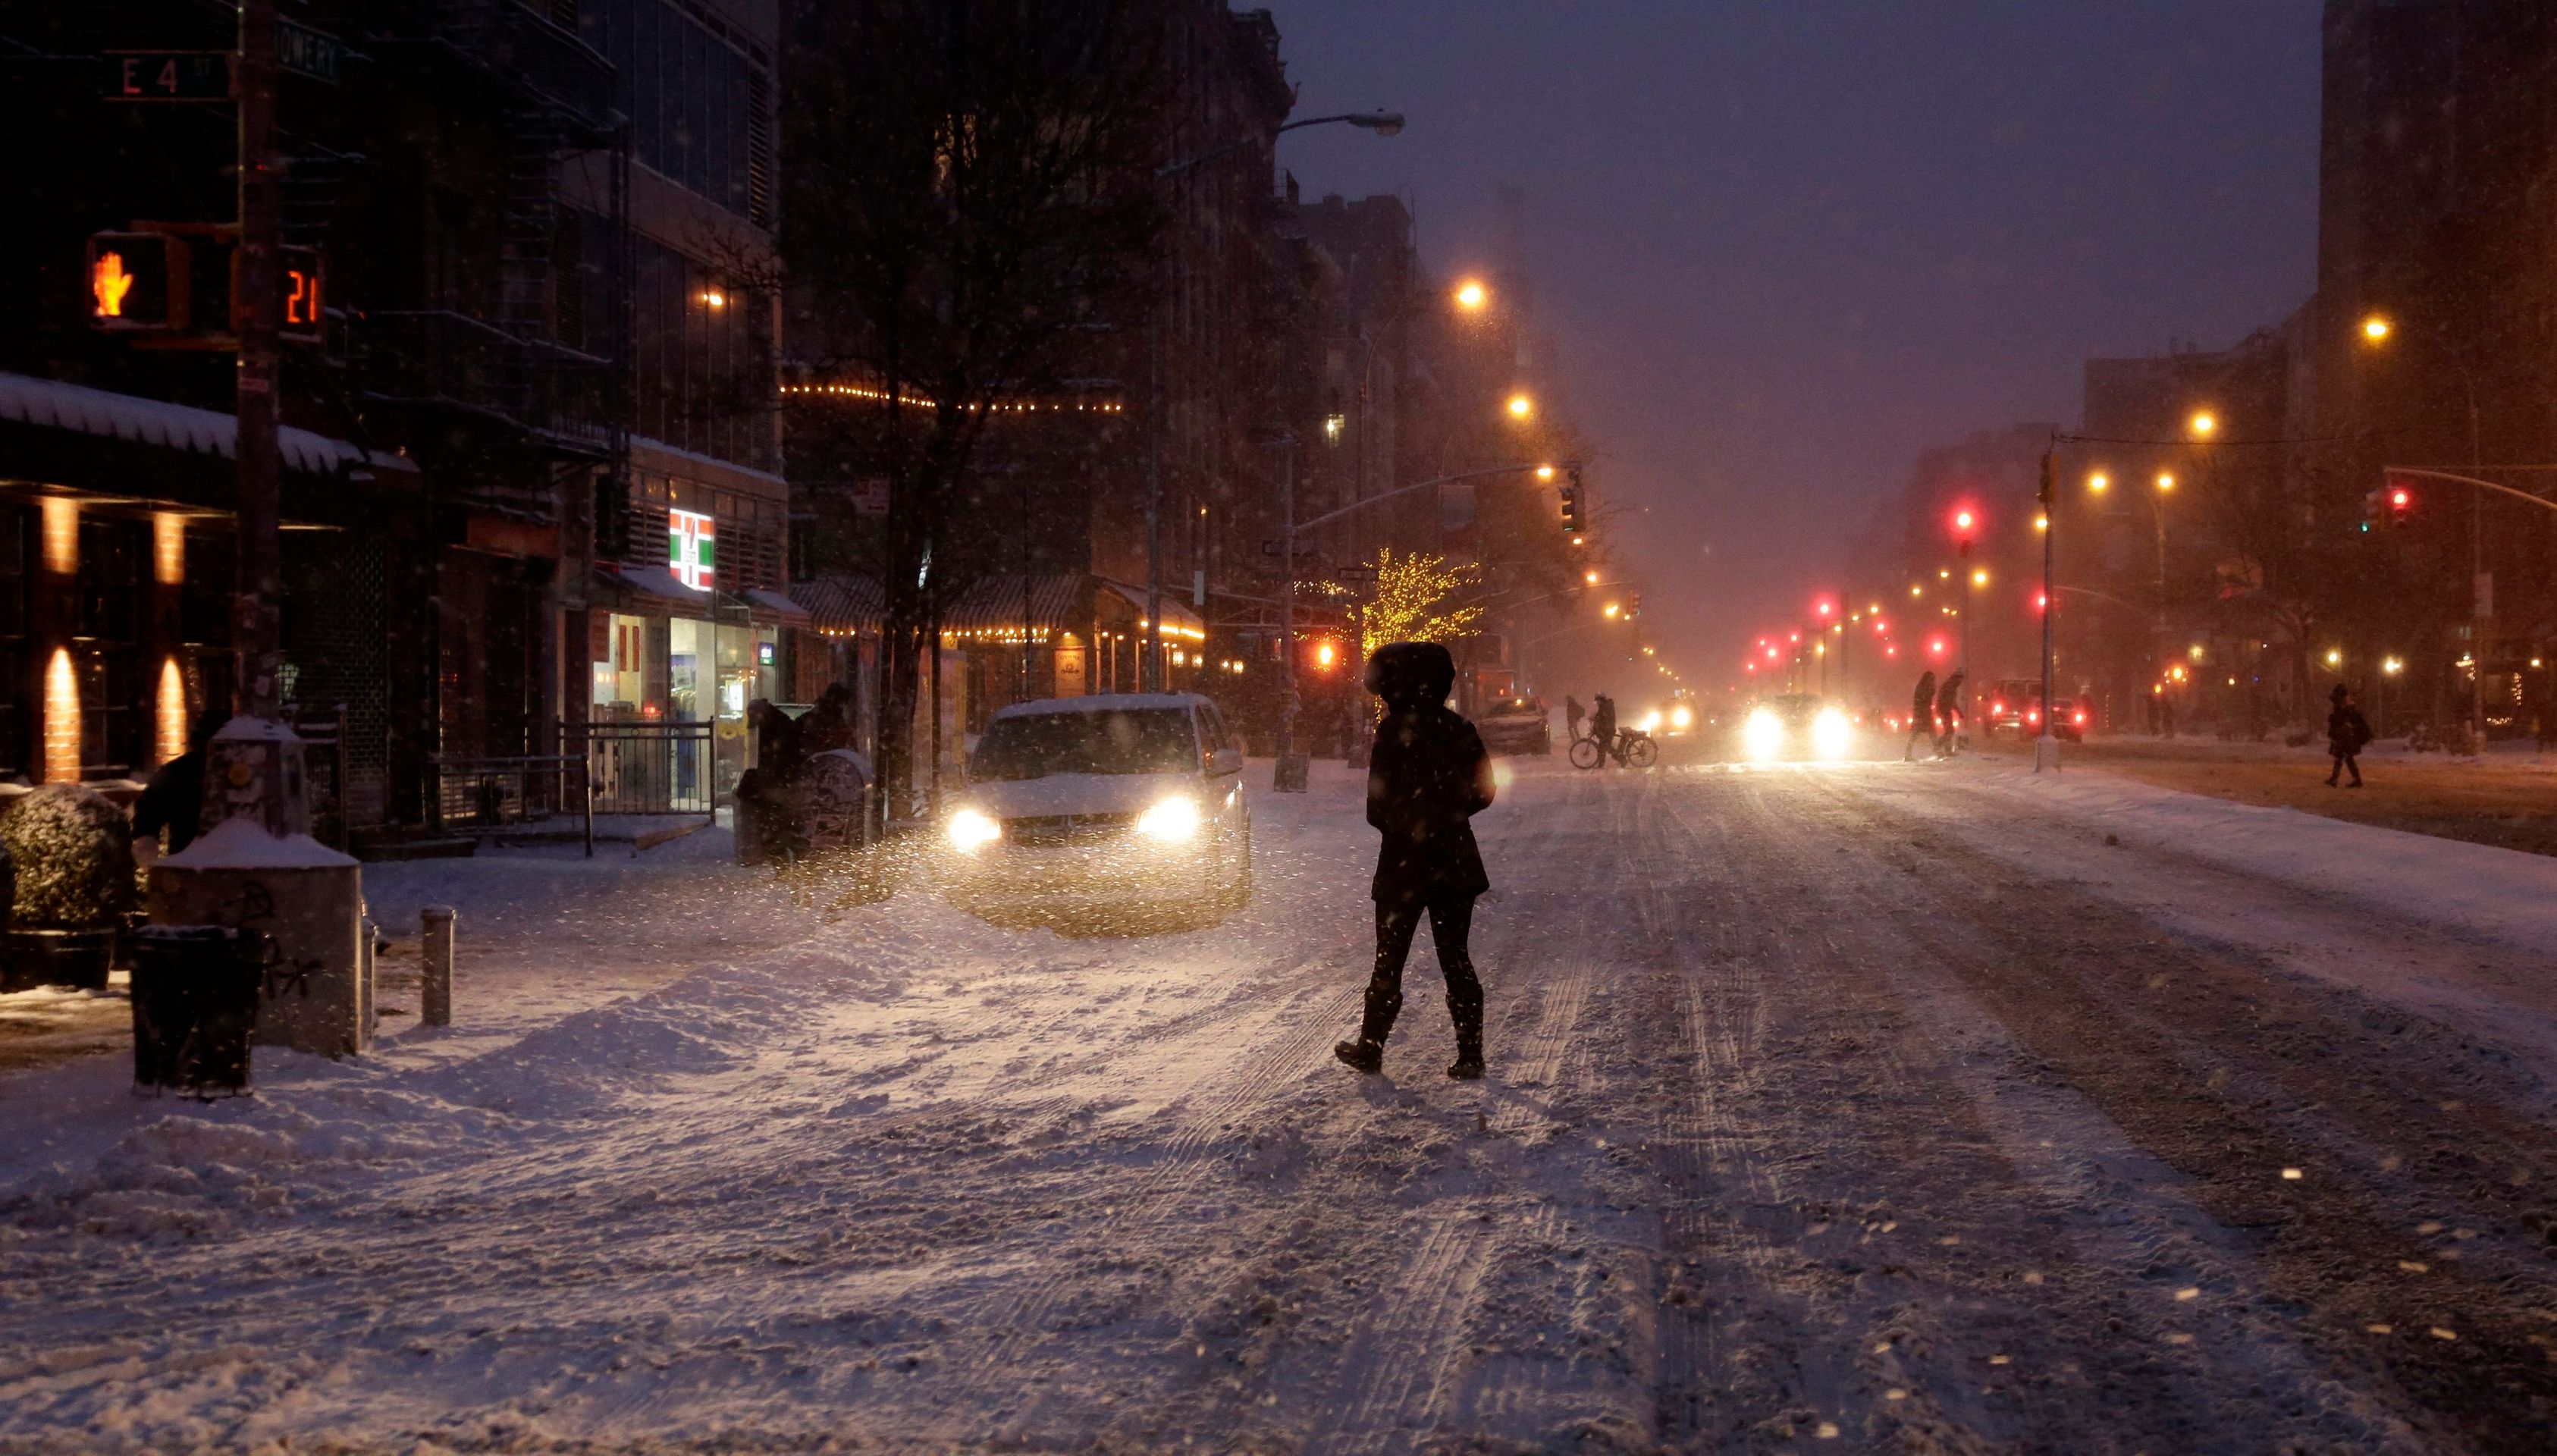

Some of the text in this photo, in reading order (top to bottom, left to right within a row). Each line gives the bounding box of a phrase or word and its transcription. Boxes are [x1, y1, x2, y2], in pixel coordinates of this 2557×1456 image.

[122, 57, 211, 94] E 4 ST
[287, 269, 316, 323] 21
